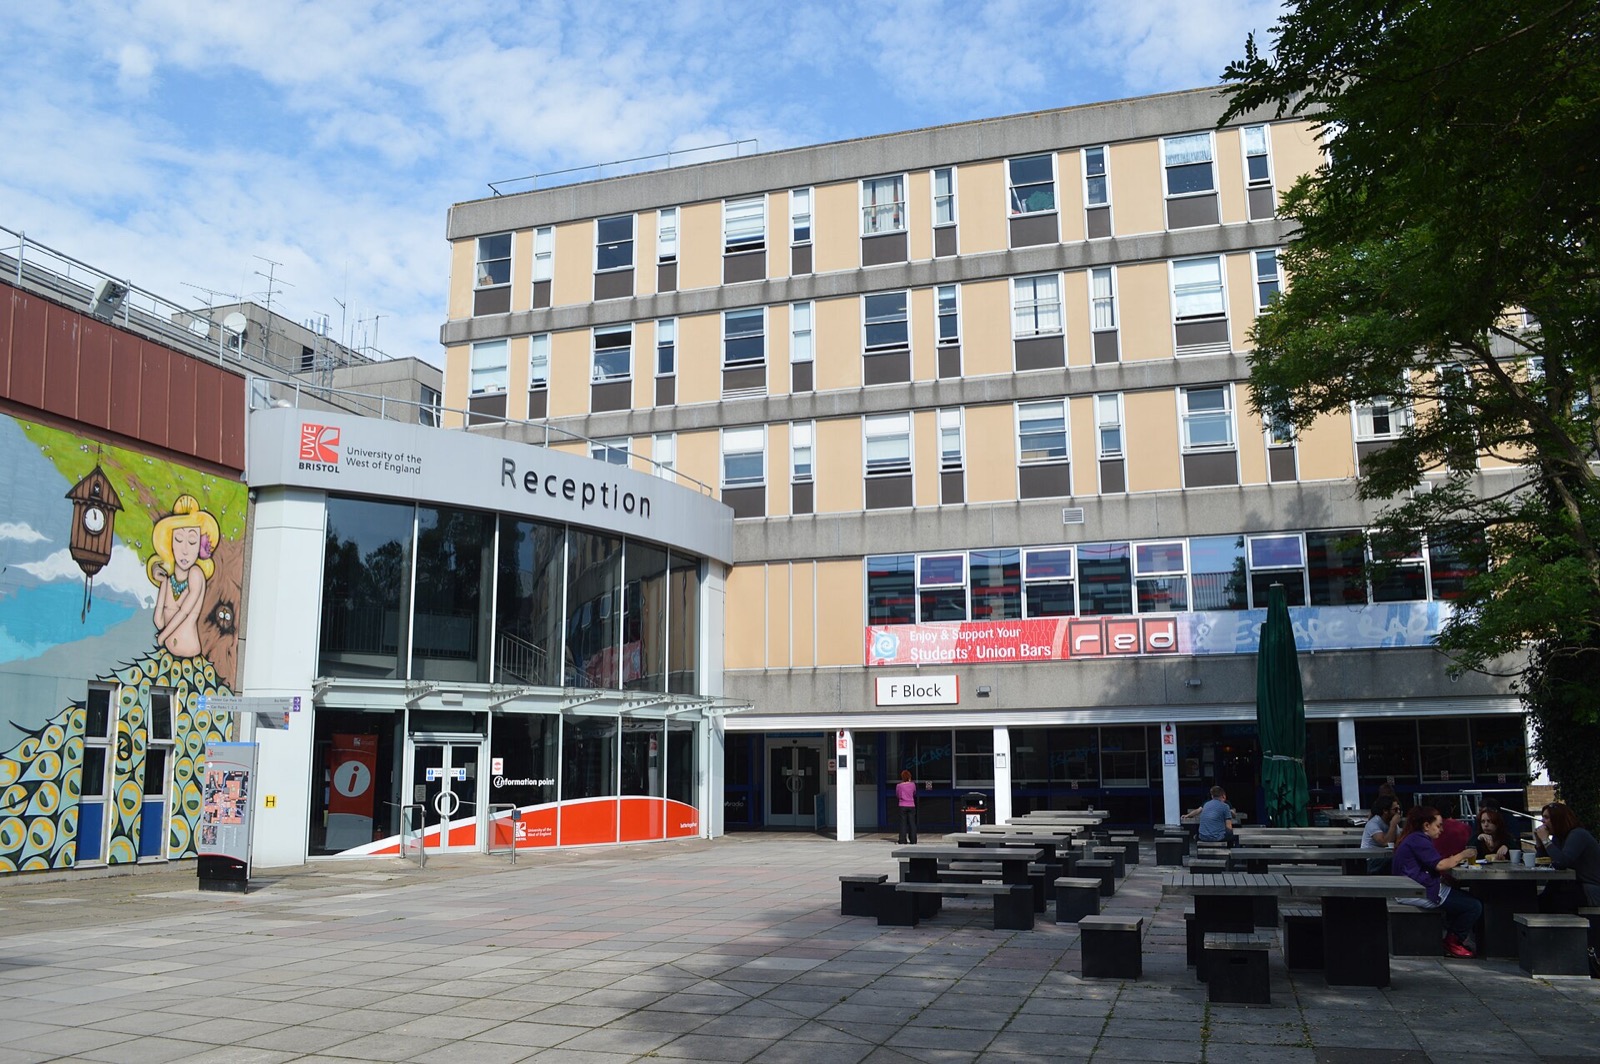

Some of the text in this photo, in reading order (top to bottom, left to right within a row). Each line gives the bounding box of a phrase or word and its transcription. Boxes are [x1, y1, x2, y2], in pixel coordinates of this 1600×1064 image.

[302, 425, 317, 458] UWE
[347, 446, 422, 464] University of the
[298, 462, 340, 473] BRISTOL
[346, 457, 421, 474] West of England
[501, 457, 651, 518] Reception
[910, 627, 1021, 643] Enjoy & Support Your
[1075, 622, 1174, 651] red
[976, 645, 1016, 658] Union
[1020, 643, 1051, 657] Bars
[890, 683, 942, 698] F Block
[538, 778, 554, 787] point
[266, 796, 275, 807] H
